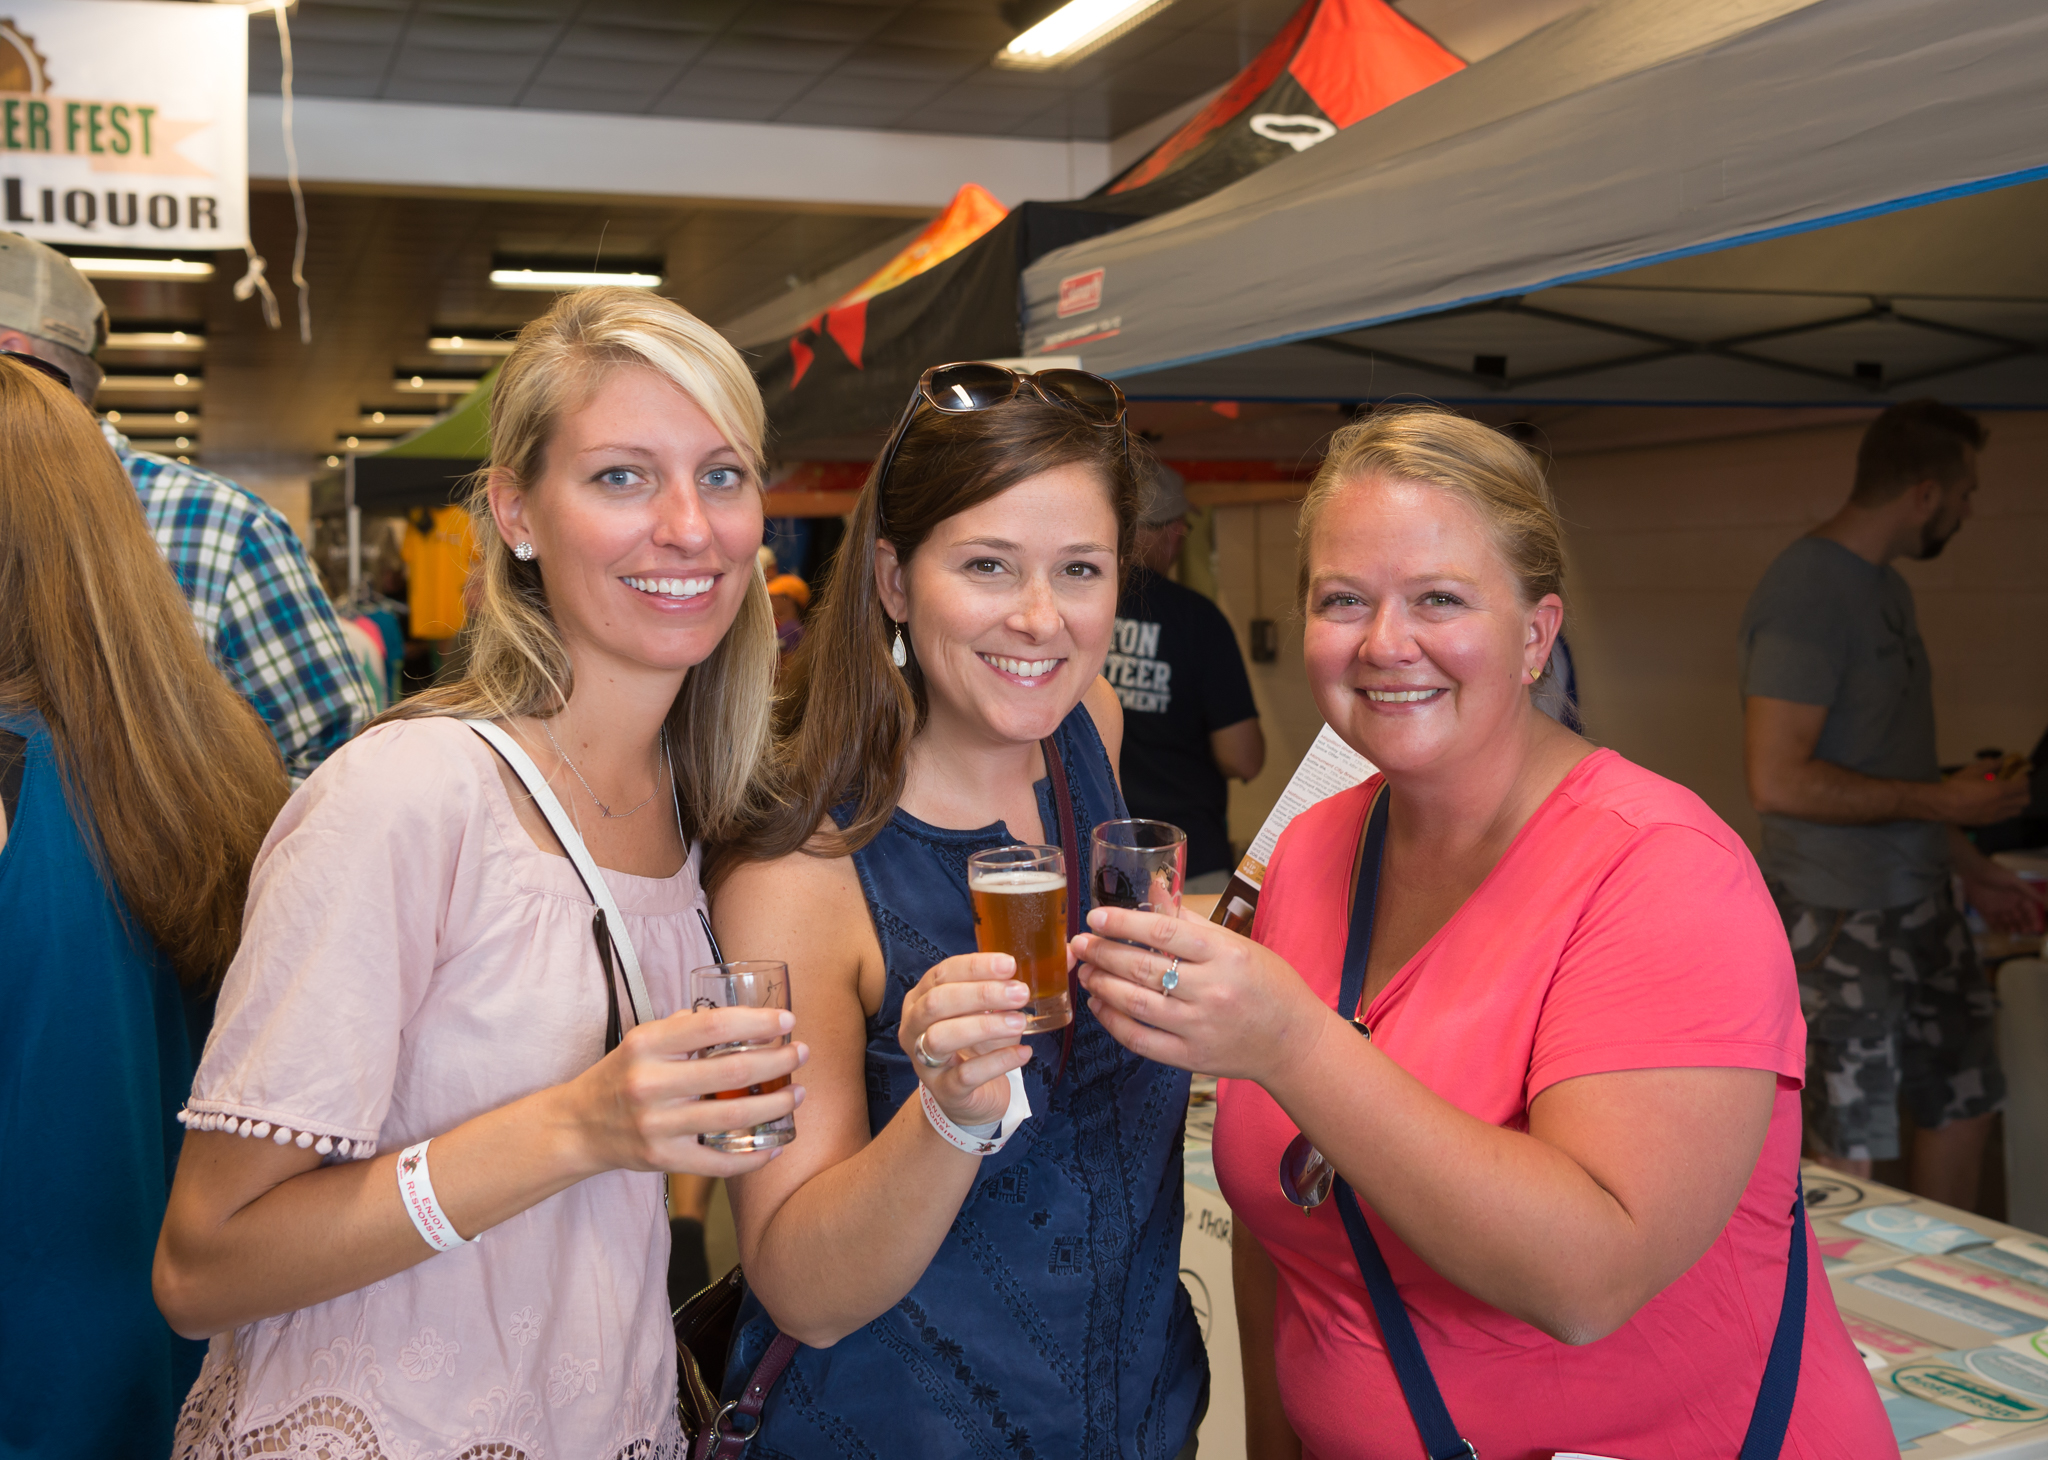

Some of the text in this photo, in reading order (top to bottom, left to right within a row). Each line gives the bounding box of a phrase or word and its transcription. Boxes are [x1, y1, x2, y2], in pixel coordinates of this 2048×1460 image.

[0, 99, 155, 155] ER FEST
[4, 177, 218, 231] LIQUOR
[1101, 652, 1172, 692] TEER
[921, 1083, 967, 1147] RESPONSIBLY
[928, 1096, 951, 1129] ENJOY
[407, 1181, 449, 1247] RESPONSIBLY
[421, 1196, 445, 1231] ENJOY
